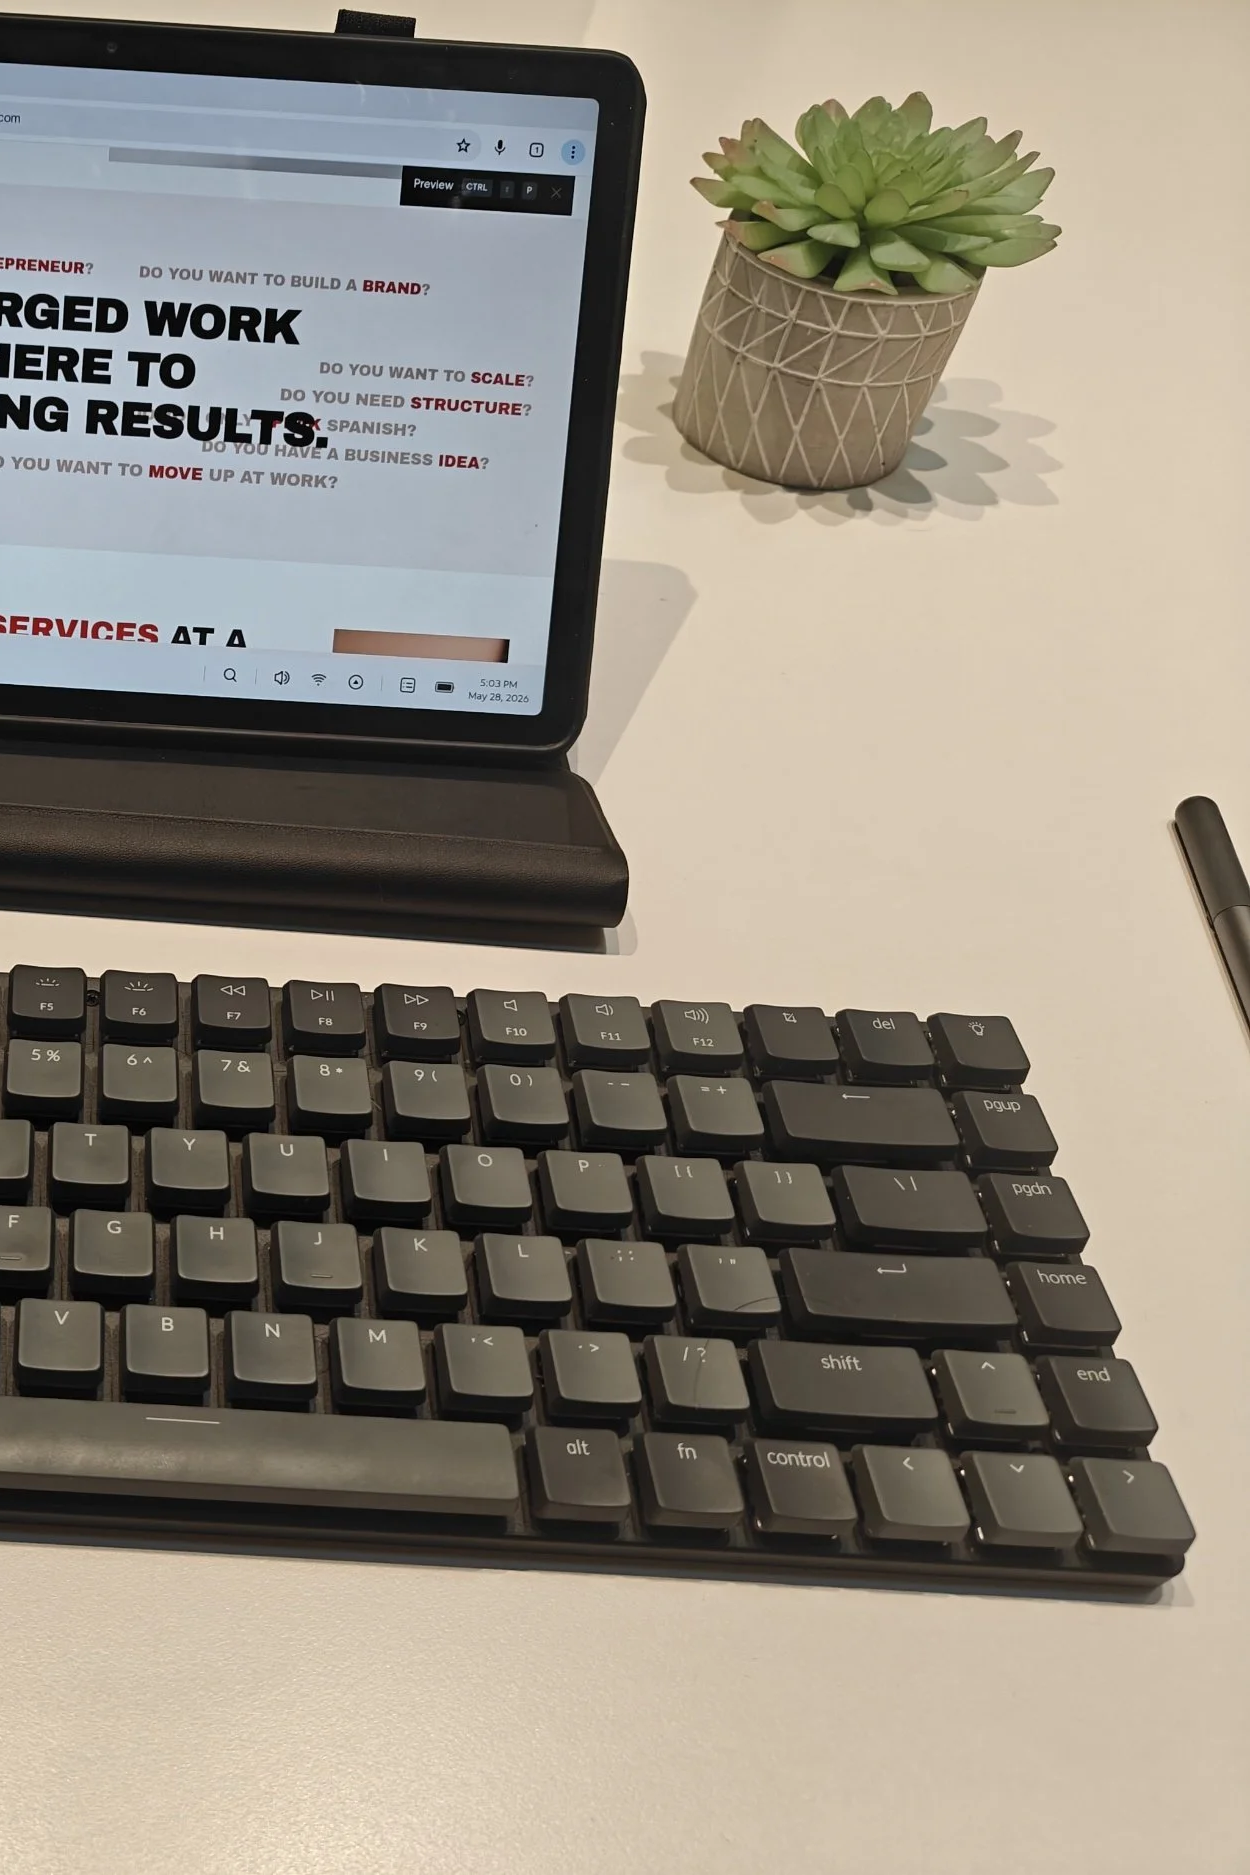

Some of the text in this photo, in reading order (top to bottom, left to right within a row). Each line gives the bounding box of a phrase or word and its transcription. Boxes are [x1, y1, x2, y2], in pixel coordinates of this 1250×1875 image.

[413, 177, 533, 194] Preview CTRL P
[139, 265, 431, 296] DO YOU WANT TO BUILD A BRAND?
[143, 300, 303, 346] WORK
[127, 350, 196, 390] TO
[319, 361, 534, 387] DO YOU WANT TO SCALE?
[280, 388, 532, 416] DO YOU NEED STRUCTURE?
[85, 399, 329, 448] RESULTS.
[326, 419, 417, 437] SPANISH?
[201, 441, 489, 470] DO YOU HAVE A BUSINESS IDEA?
[10, 456, 51, 472] YOU
[56, 458, 113, 476] WANT
[117, 462, 143, 477] TO
[148, 464, 204, 481] MOVE
[209, 468, 235, 483] UP
[239, 470, 265, 485] AT
[269, 471, 338, 489] WORK?
[171, 626, 215, 646] AT
[226, 629, 246, 648] A
[479, 678, 518, 689] 5:03 PM
[468, 691, 530, 703] May 28, 2026
[39, 1002, 54, 1011] F5
[132, 1007, 147, 1016] F6
[226, 1011, 242, 1021] F7
[318, 1017, 333, 1026] F8
[872, 1017, 896, 1030] del
[413, 1021, 428, 1031] F9
[505, 1027, 528, 1037] F10
[600, 1031, 622, 1041] F11
[692, 1037, 714, 1047] F12
[983, 1099, 1021, 1113] pgup
[84, 1133, 97, 1147] T
[182, 1137, 196, 1151] Y
[279, 1143, 294, 1157] U
[477, 1153, 493, 1167] O
[578, 1159, 590, 1173] P
[1011, 1181, 1052, 1197] pgdn
[8, 1214, 20, 1228] F
[106, 1220, 122, 1234] G
[209, 1226, 224, 1241] H
[313, 1231, 323, 1246] J
[413, 1237, 428, 1252] K
[517, 1243, 529, 1258] L
[1036, 1269, 1087, 1285] home
[820, 1354, 863, 1371] shift
[1076, 1366, 1111, 1382] end
[566, 1439, 591, 1456] alt
[677, 1442, 698, 1460] fn
[767, 1451, 831, 1469] control
